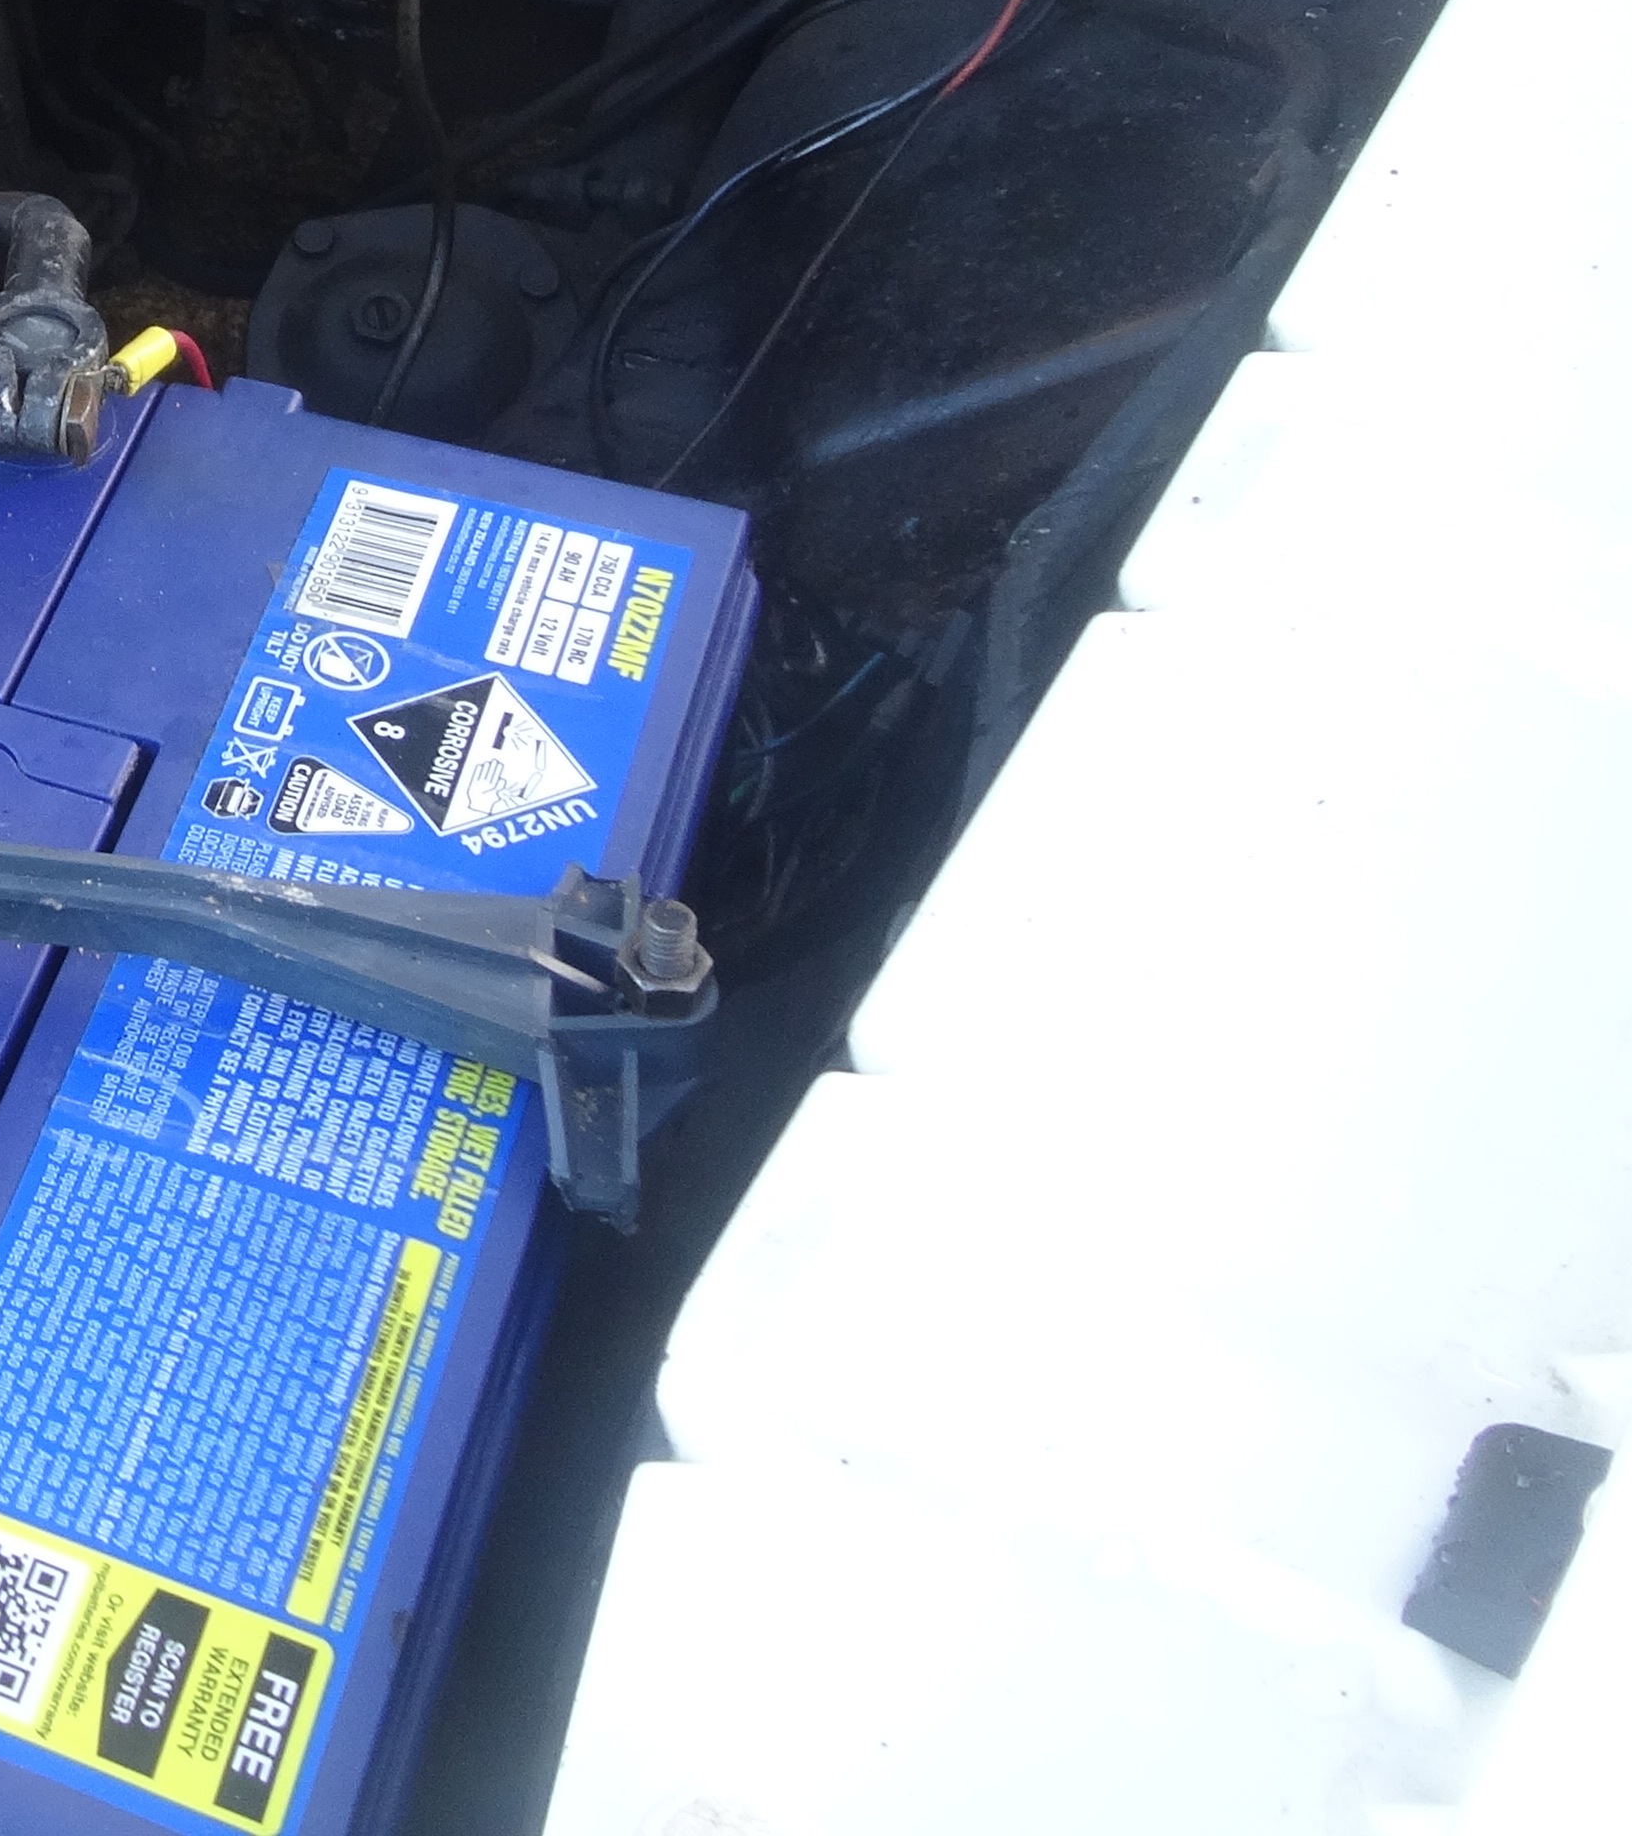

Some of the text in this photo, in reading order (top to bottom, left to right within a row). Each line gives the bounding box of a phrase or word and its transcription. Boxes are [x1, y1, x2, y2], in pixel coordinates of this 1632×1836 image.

[304, 486, 369, 603] 9 313122 901850
[556, 550, 582, 583] 90 AH
[496, 531, 551, 656] 14.8V max vehicle charge rate
[589, 553, 619, 598] 750 CCA
[262, 628, 289, 657] TILT
[288, 622, 312, 645] DO
[530, 617, 559, 656] 12 Volt
[566, 625, 595, 665] 170 RC
[603, 565, 675, 682] N70ZZMF
[276, 644, 303, 672] NOT
[246, 685, 273, 727] UPRIGHT
[262, 696, 283, 723] KEEP
[371, 719, 407, 741] 8
[424, 699, 480, 797] CORROSIVE
[273, 762, 312, 822] CAUTION
[329, 793, 348, 818] LOAD
[341, 793, 364, 826] ASSESS
[460, 797, 597, 857] UN2794
[110, 996, 152, 1065] AUTHORISED
[138, 1021, 162, 1045] SEE
[169, 998, 191, 1018] OR
[115, 1049, 151, 1100] WEBSITE
[139, 977, 220, 1140] BATTERY TO OUR AUTHORISED
[184, 992, 264, 1155] CONTACT SEE A PHYSICIAN
[241, 1031, 274, 1073] LARGE
[265, 1045, 293, 1077] SKIN
[281, 1038, 320, 1101] CONTAINS
[333, 1055, 365, 1095] WHEN
[357, 1056, 389, 1099] METAL
[85, 1072, 120, 1124] BATTERY
[133, 1085, 155, 1106] DO
[217, 1078, 255, 1135] AMOUNT
[256, 1077, 281, 1099] OR
[374, 1068, 410, 1122] LIGHTED
[103, 1104, 128, 1129] FOR
[121, 1108, 146, 1135] NOT
[253, 1102, 296, 1178] SULPHURIC
[308, 1097, 350, 1165] CHARGING
[337, 1099, 374, 1156] OBJECTS
[387, 1094, 428, 1162] EXPLOSIVE
[206, 1141, 231, 1163] OF
[275, 1125, 314, 1185] PROVIDE
[345, 1125, 391, 1206] CIGARETTES
[456, 1121, 501, 1172] WET
[299, 1167, 324, 1191] OR
[322, 1156, 354, 1199] AWAY
[434, 1166, 487, 1241] FILLED
[65, 1591, 125, 1719] Or visit website:
[107, 1622, 163, 1726] REGISTER
[136, 1637, 187, 1731] SCAN TO
[173, 1644, 229, 1759] WARRANTY
[197, 1655, 250, 1764] EXTENDED
[227, 1668, 300, 1784] FREE
